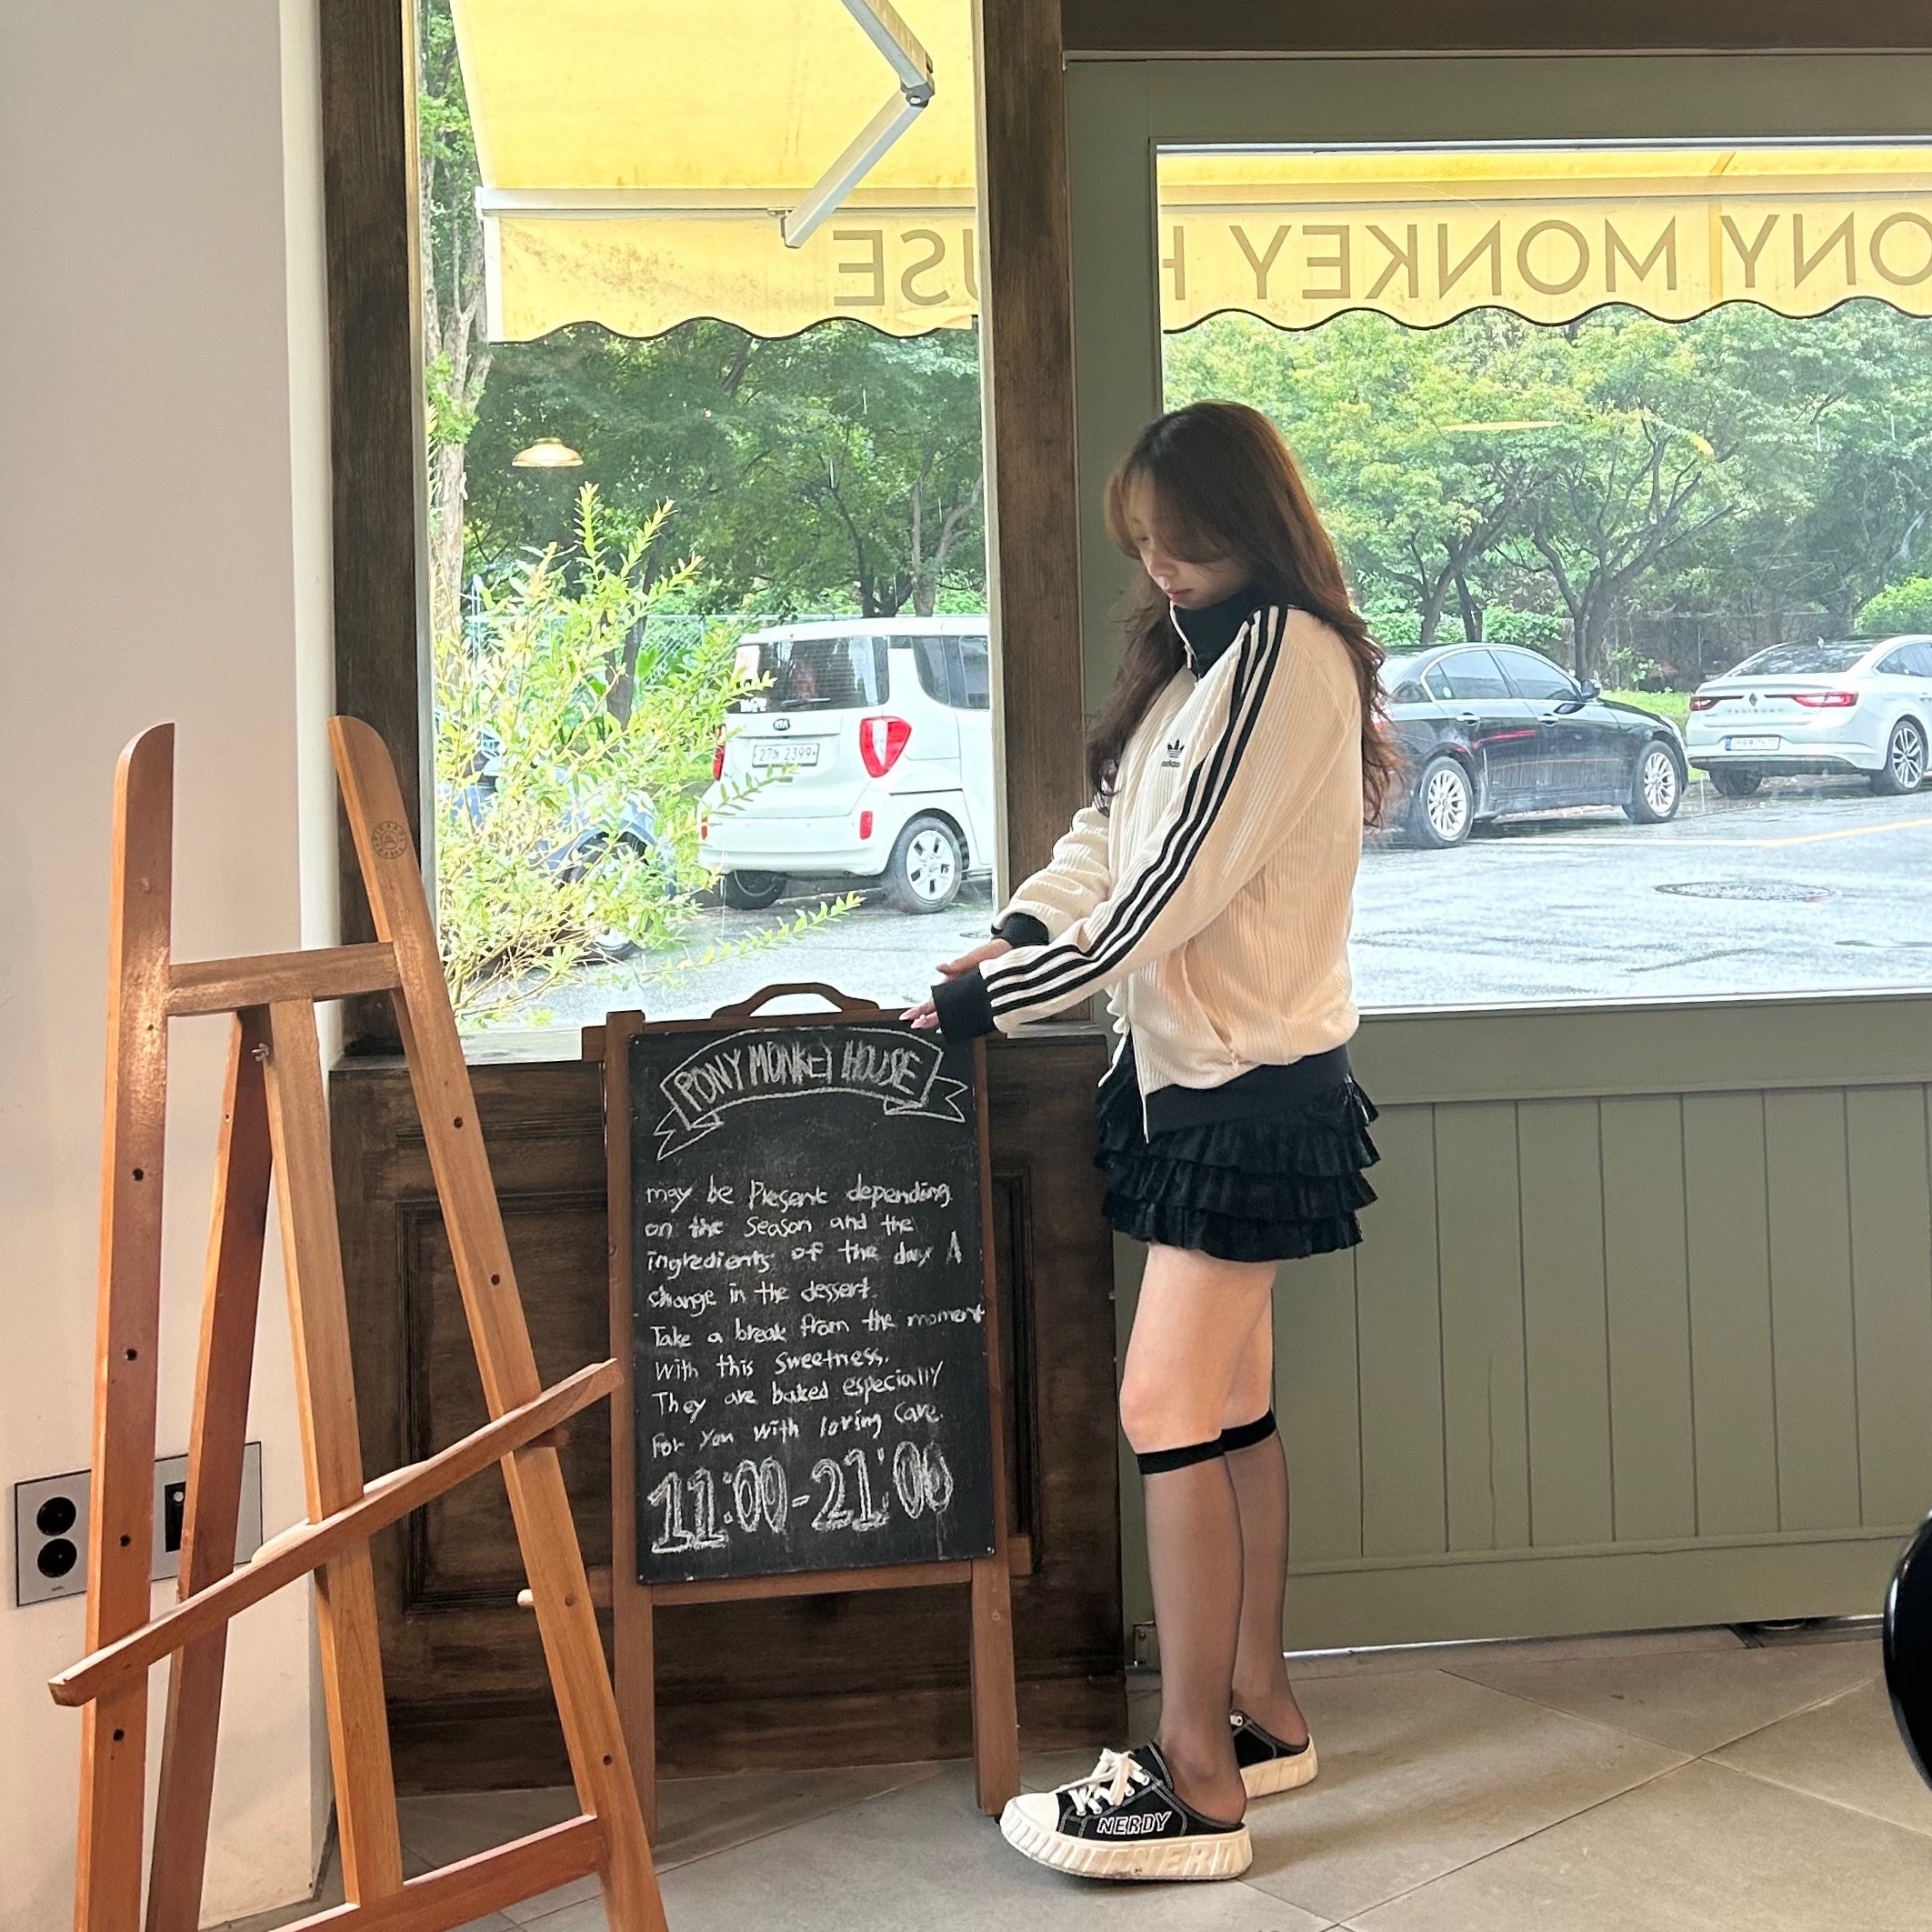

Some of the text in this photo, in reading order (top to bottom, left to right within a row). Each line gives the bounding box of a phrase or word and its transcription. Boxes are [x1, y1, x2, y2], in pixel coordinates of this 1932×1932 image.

[674, 1040, 923, 1111] PONY MONKEY HOUSE
[706, 1174, 735, 1205] be
[846, 1173, 953, 1208] depending
[645, 1222, 673, 1239] on
[688, 1215, 724, 1238] the
[830, 1213, 867, 1230] and
[880, 1214, 914, 1236] the
[646, 1250, 775, 1280] ingredients
[791, 1241, 824, 1262] of
[837, 1239, 878, 1264] the
[946, 1230, 962, 1265] A
[728, 1283, 746, 1304] in
[754, 1280, 789, 1306] the
[650, 1303, 986, 1347] Take a break from the moment
[716, 1354, 754, 1378] this
[651, 1360, 944, 1424] They are baked especially
[820, 1408, 882, 1439] loving
[1096, 1811, 1172, 1835] NERDY
